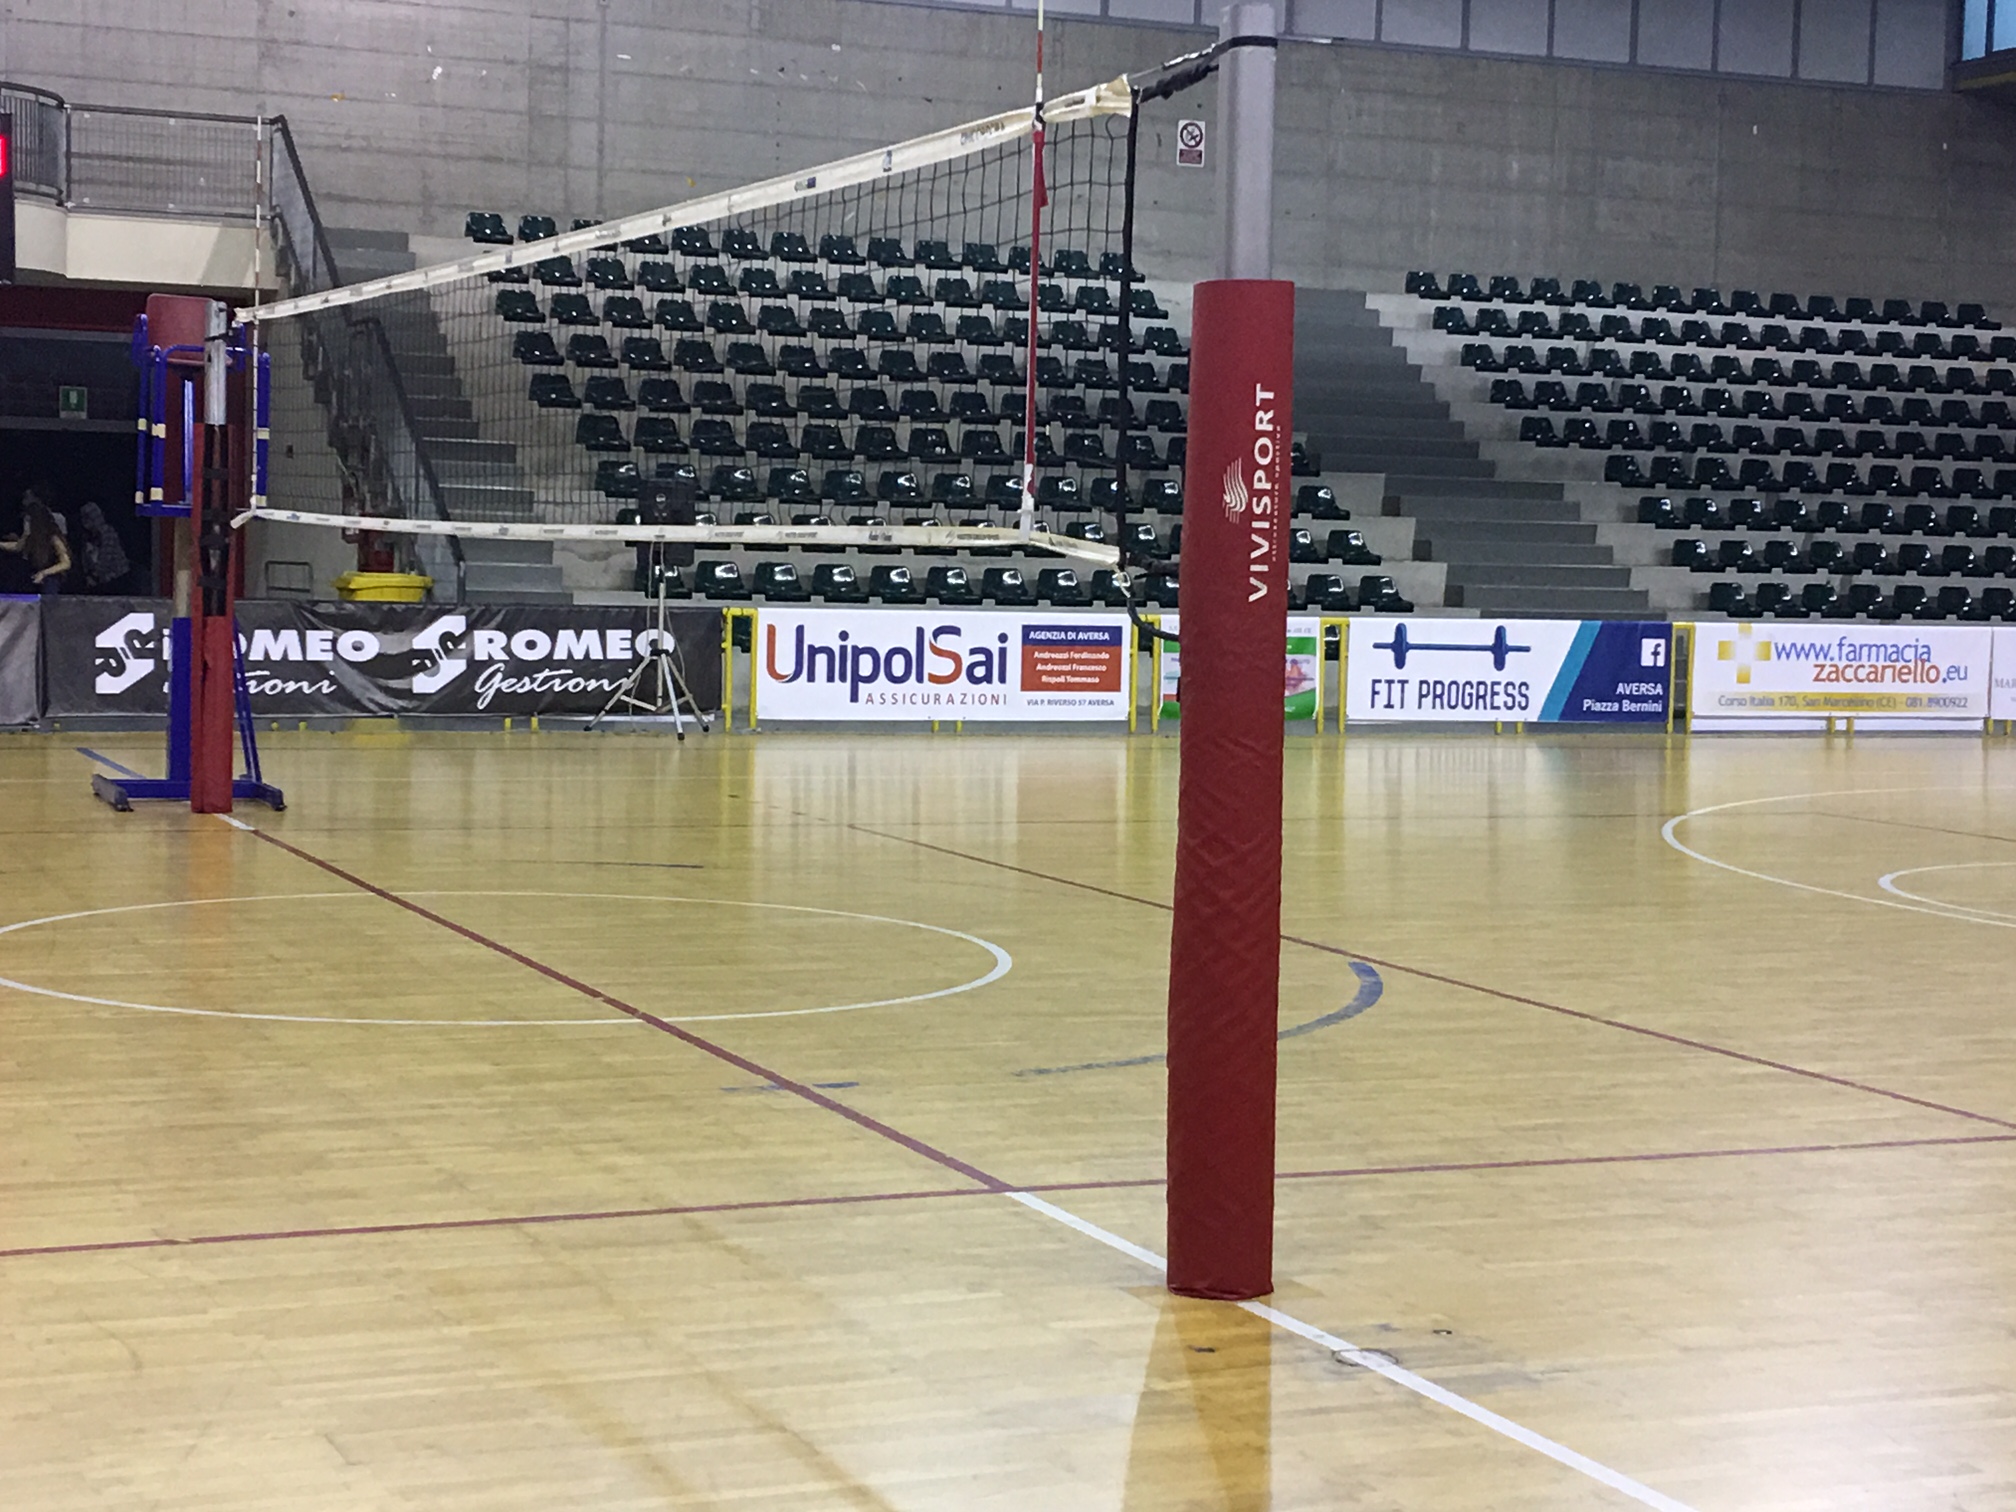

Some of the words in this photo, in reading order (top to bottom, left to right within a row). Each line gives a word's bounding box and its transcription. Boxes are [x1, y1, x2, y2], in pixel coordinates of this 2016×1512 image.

[1248, 383, 1275, 602] VIVISPORT
[1028, 631, 1066, 640] AGENZIA
[1067, 632, 1076, 640] DI
[1077, 631, 1110, 641] AVERSA
[473, 629, 676, 661] ROMEO
[1774, 636, 1932, 662] www.farmacia
[766, 624, 1009, 703] UnipolSai
[1072, 663, 1107, 672] Francesco
[474, 663, 635, 710] Gestioni
[1615, 682, 1663, 696] AVERSA
[865, 692, 1008, 706] ASSICURAZIONI
[1370, 679, 1409, 709] FIT
[1417, 679, 1530, 711] PROGRESS
[1718, 695, 1747, 707] Corso
[1749, 695, 1775, 707] Italia
[1801, 695, 1821, 707] San
[1027, 699, 1039, 707] VIA
[1047, 699, 1077, 707] RIVERSO
[1088, 699, 1115, 707] AVERSA
[1582, 699, 1619, 712] Piazza
[1621, 700, 1663, 713] Bernini
